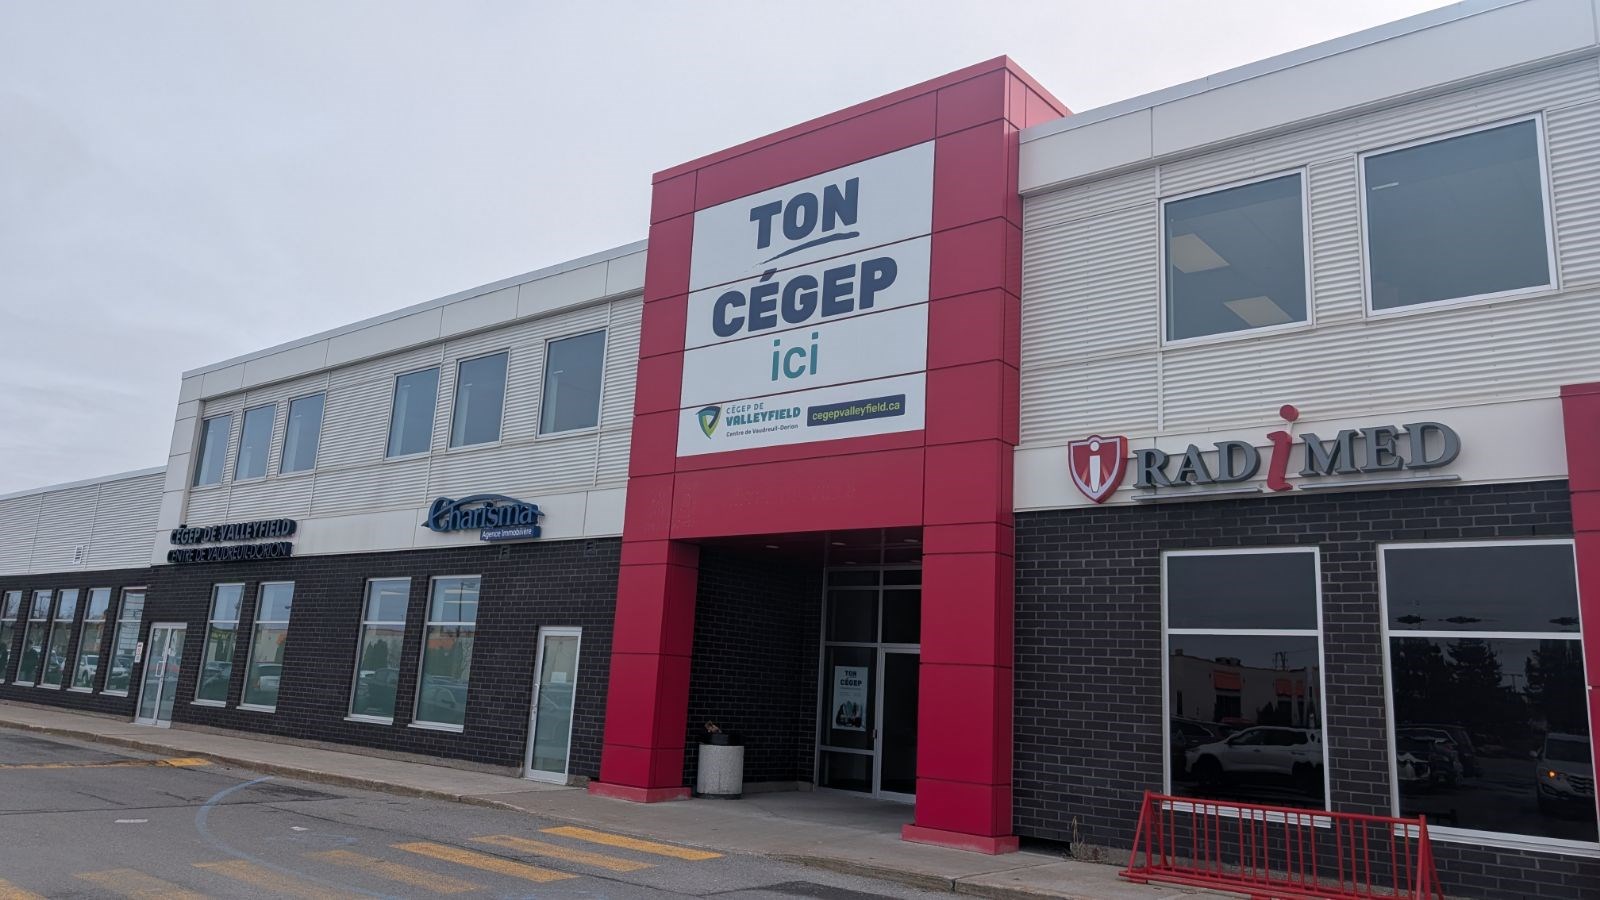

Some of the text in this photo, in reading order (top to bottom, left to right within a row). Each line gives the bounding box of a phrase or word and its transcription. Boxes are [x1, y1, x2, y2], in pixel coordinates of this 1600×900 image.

[750, 177, 859, 249] TON
[712, 257, 898, 337] CÉGEP
[771, 332, 819, 381] ici
[726, 402, 764, 414] CÉGEP DE
[726, 406, 801, 427] VALLEYFIELD
[812, 401, 900, 421] cegepvalleyfield.ca
[726, 430, 743, 438] Centre
[428, 496, 538, 532] Charisma
[203, 526, 217, 542] DE
[219, 518, 295, 541] VALLEYFIELD
[168, 549, 194, 562] ENTRE
[844, 670, 857, 678] TON
